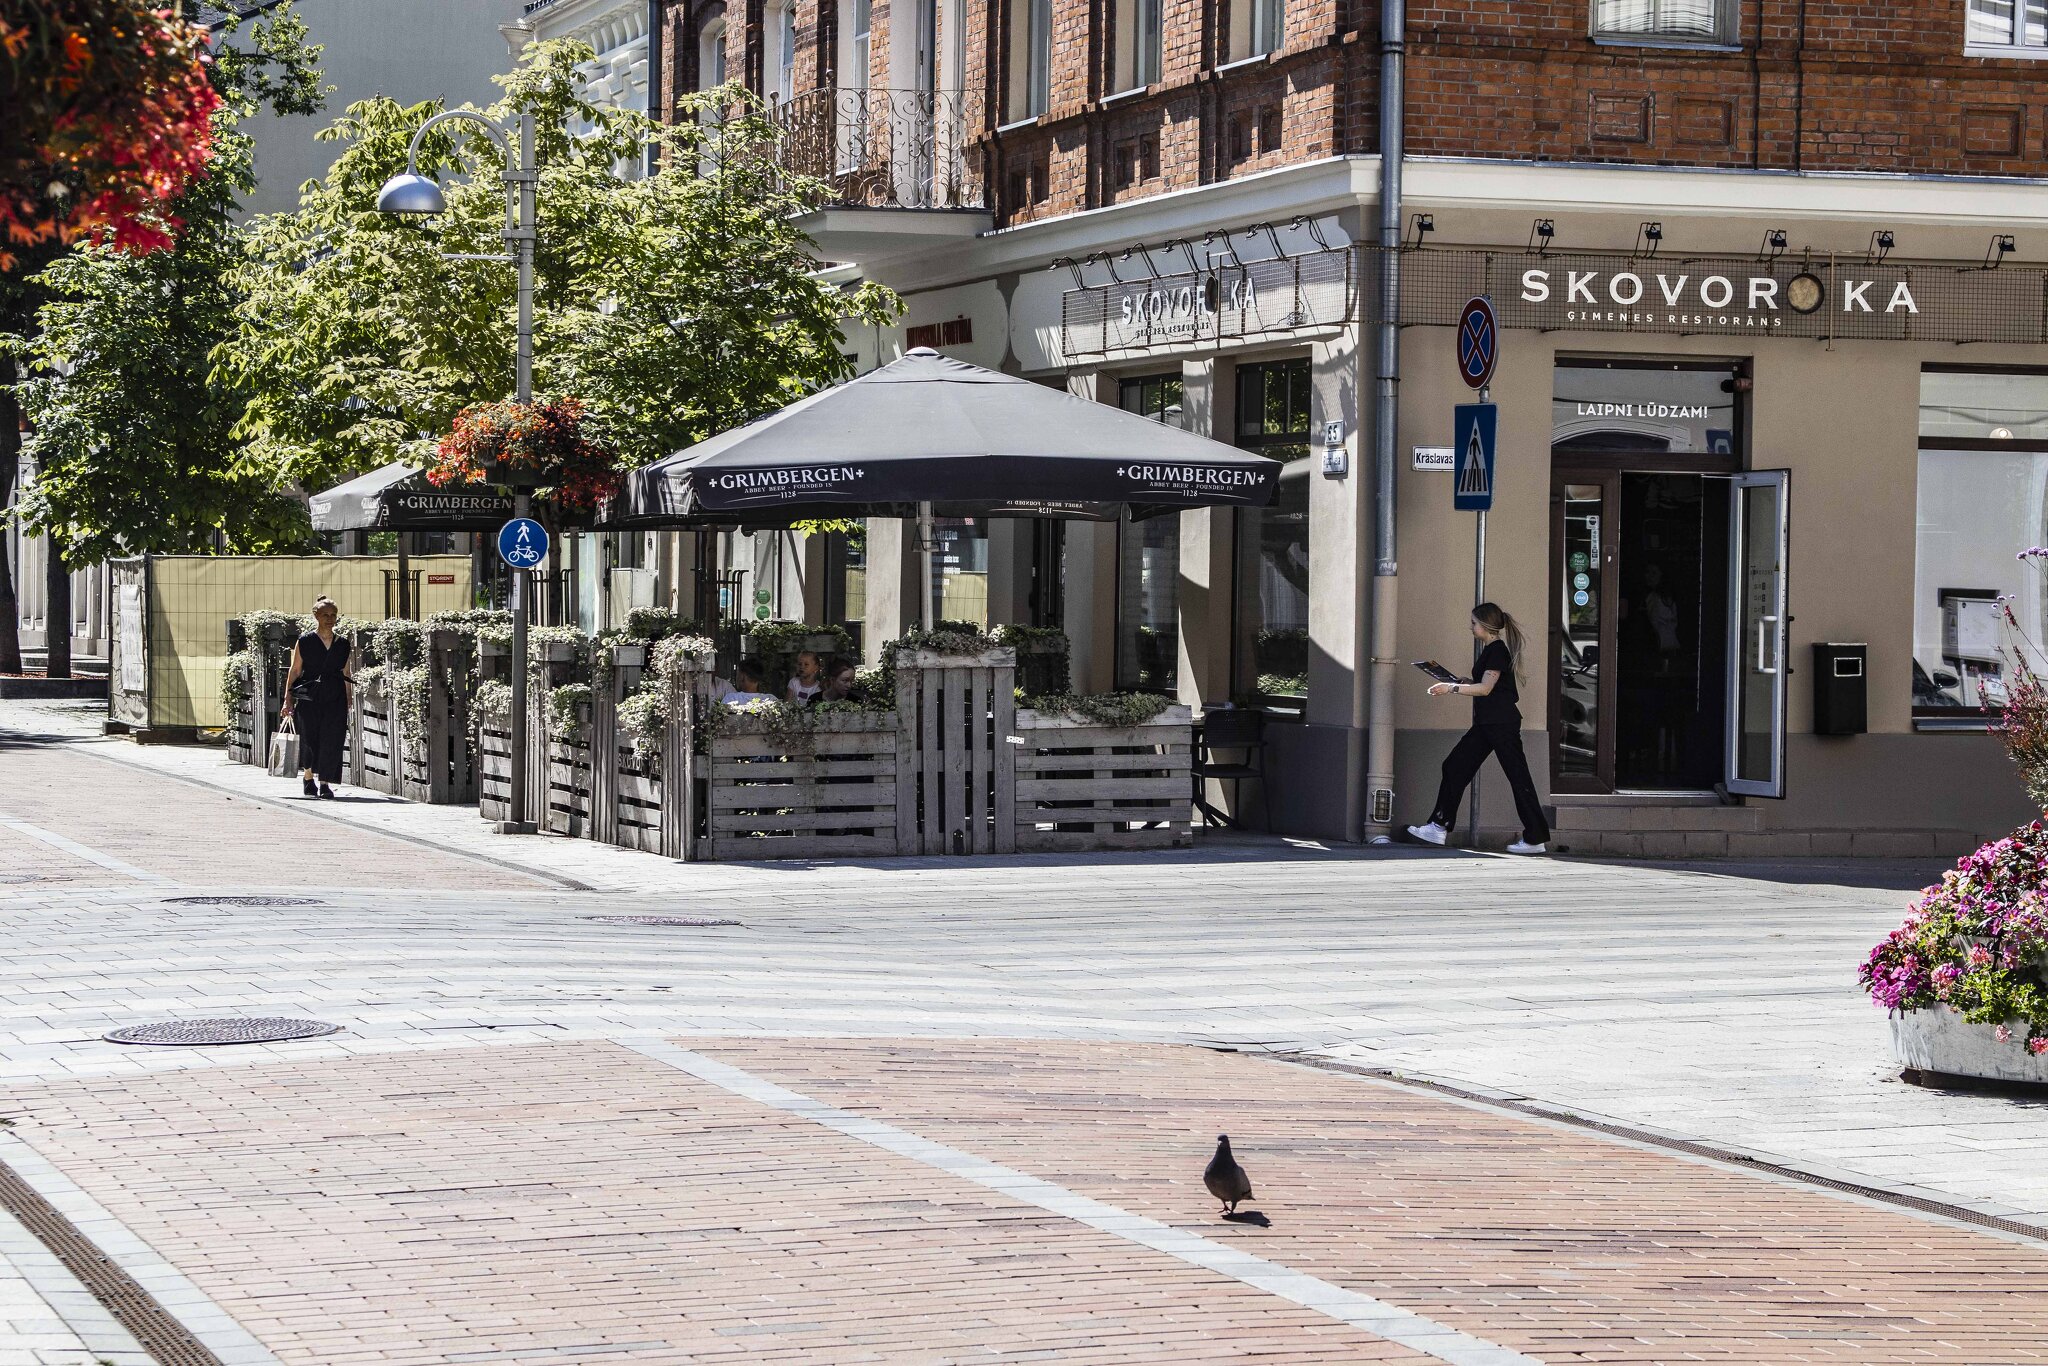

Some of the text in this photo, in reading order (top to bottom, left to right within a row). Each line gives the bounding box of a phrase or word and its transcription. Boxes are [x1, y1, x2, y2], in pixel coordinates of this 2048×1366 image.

[1567, 311, 1782, 327] ĢIMENES RESTORĀNS
[1577, 402, 1708, 418] LAIPNI LŪDZAM!
[1327, 425, 1338, 441] 65
[720, 467, 855, 489] GRIMBERGEN
[1127, 465, 1256, 486] GRIMBERGEN
[780, 491, 797, 499] 1128
[1182, 489, 1198, 497] 1128
[406, 496, 512, 509] GRIMBERGEN
